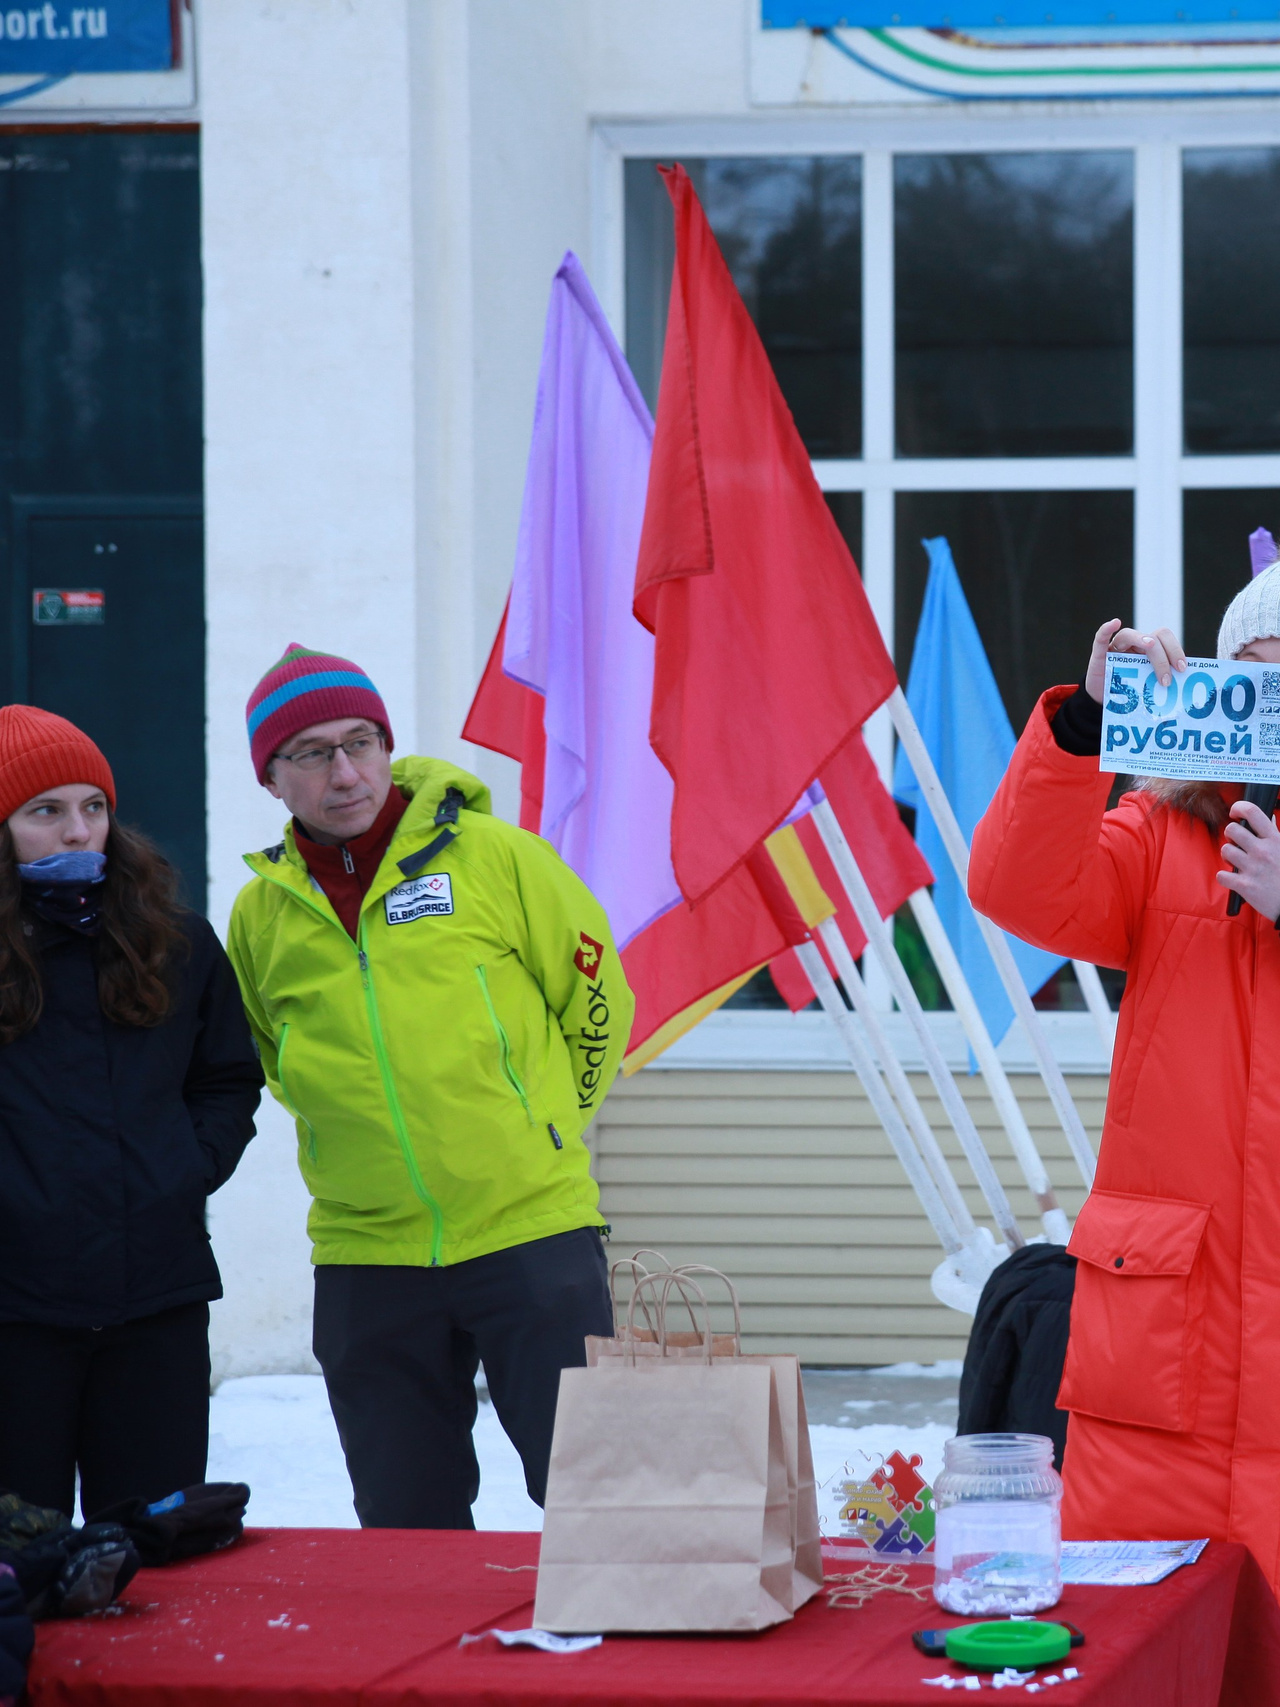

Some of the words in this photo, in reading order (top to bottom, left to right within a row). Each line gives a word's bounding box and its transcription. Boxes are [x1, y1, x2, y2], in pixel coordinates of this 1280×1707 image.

[1107, 656, 1151, 665] СЛЮДОРУДН
[1198, 661, 1219, 669] ДОМА
[1105, 666, 1256, 722] 5000
[1106, 719, 1253, 755] рублей
[1183, 753, 1226, 761] СЕРТИФИКАТ
[1126, 764, 1168, 772] СЕРТИФИКАТ
[389, 902, 451, 922] ELBRUSRACE
